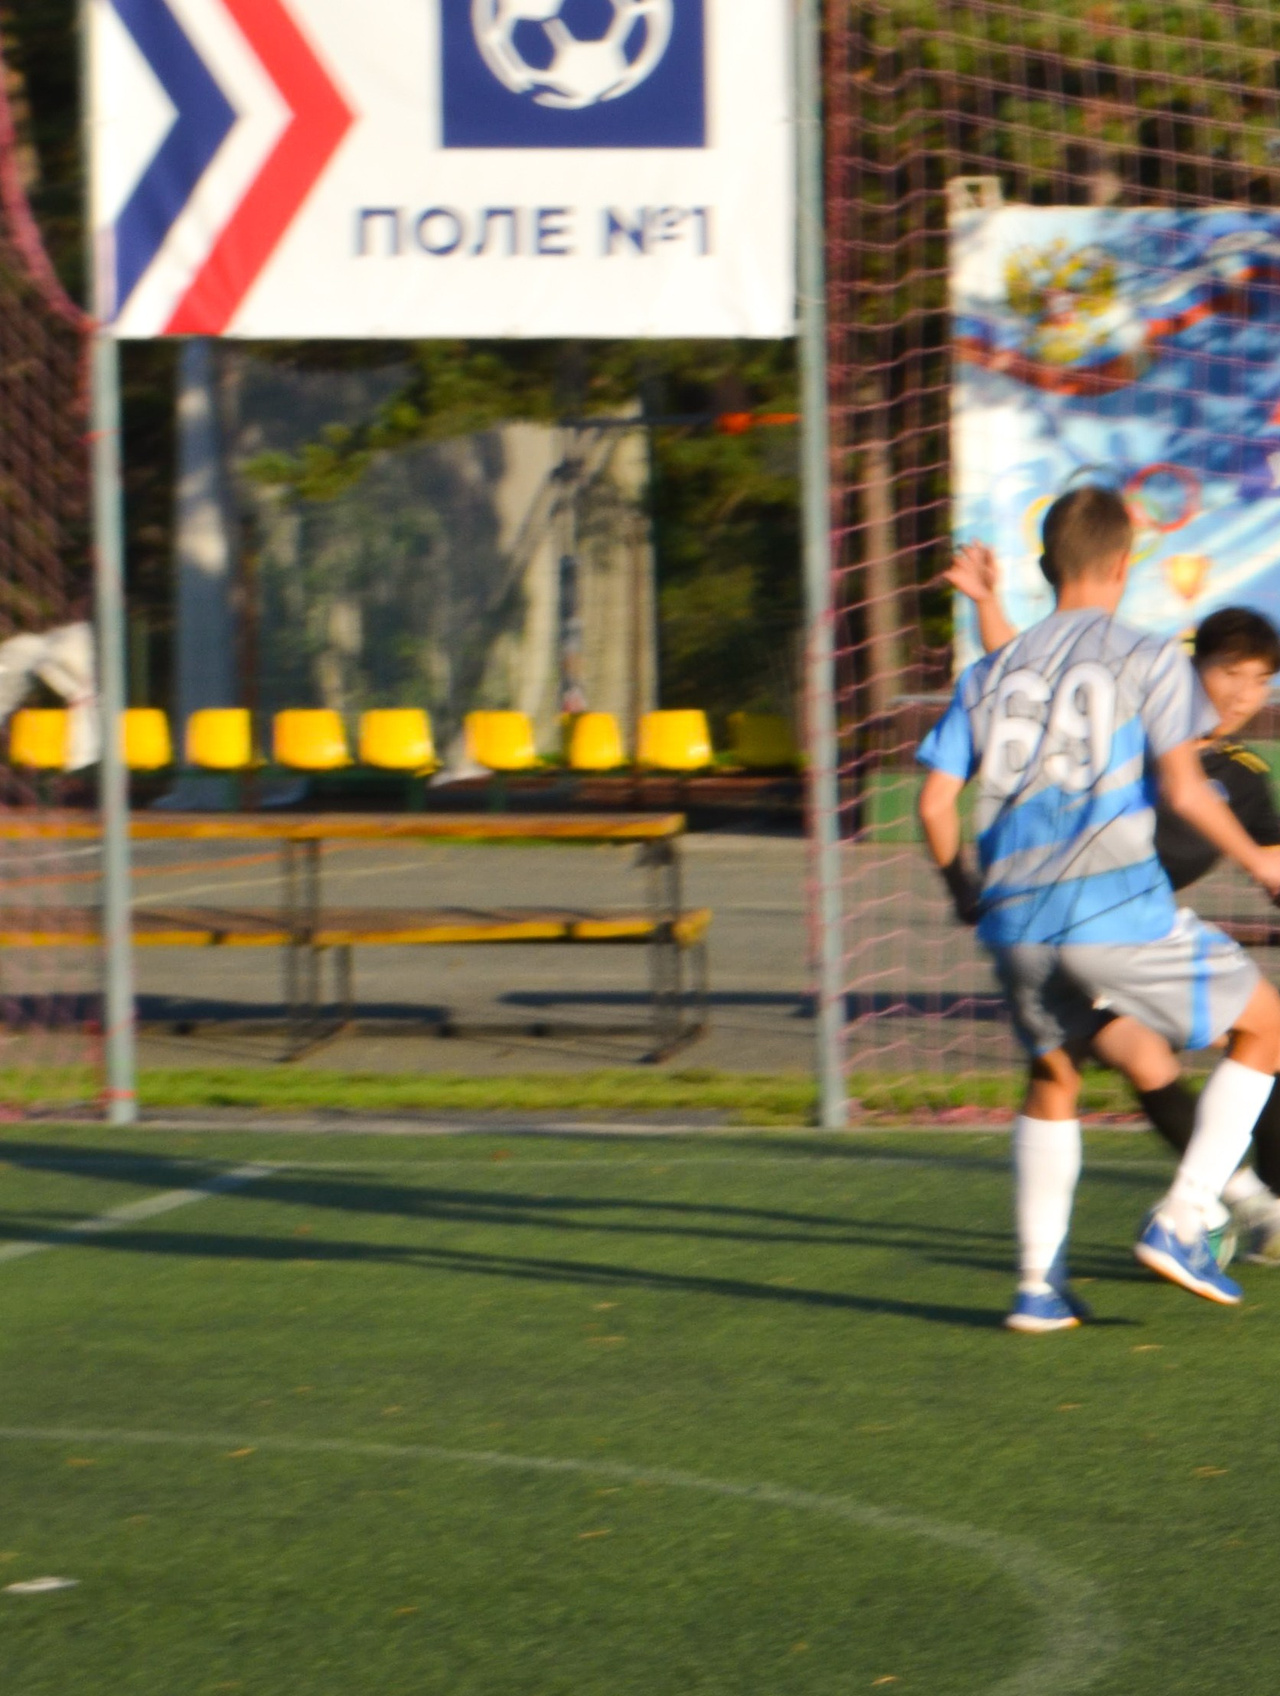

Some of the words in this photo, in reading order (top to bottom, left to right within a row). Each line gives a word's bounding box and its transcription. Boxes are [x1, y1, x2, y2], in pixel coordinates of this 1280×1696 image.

[354, 205, 574, 256] ПОЛЕ
[602, 205, 714, 256] №1
[982, 662, 1116, 792] 69
